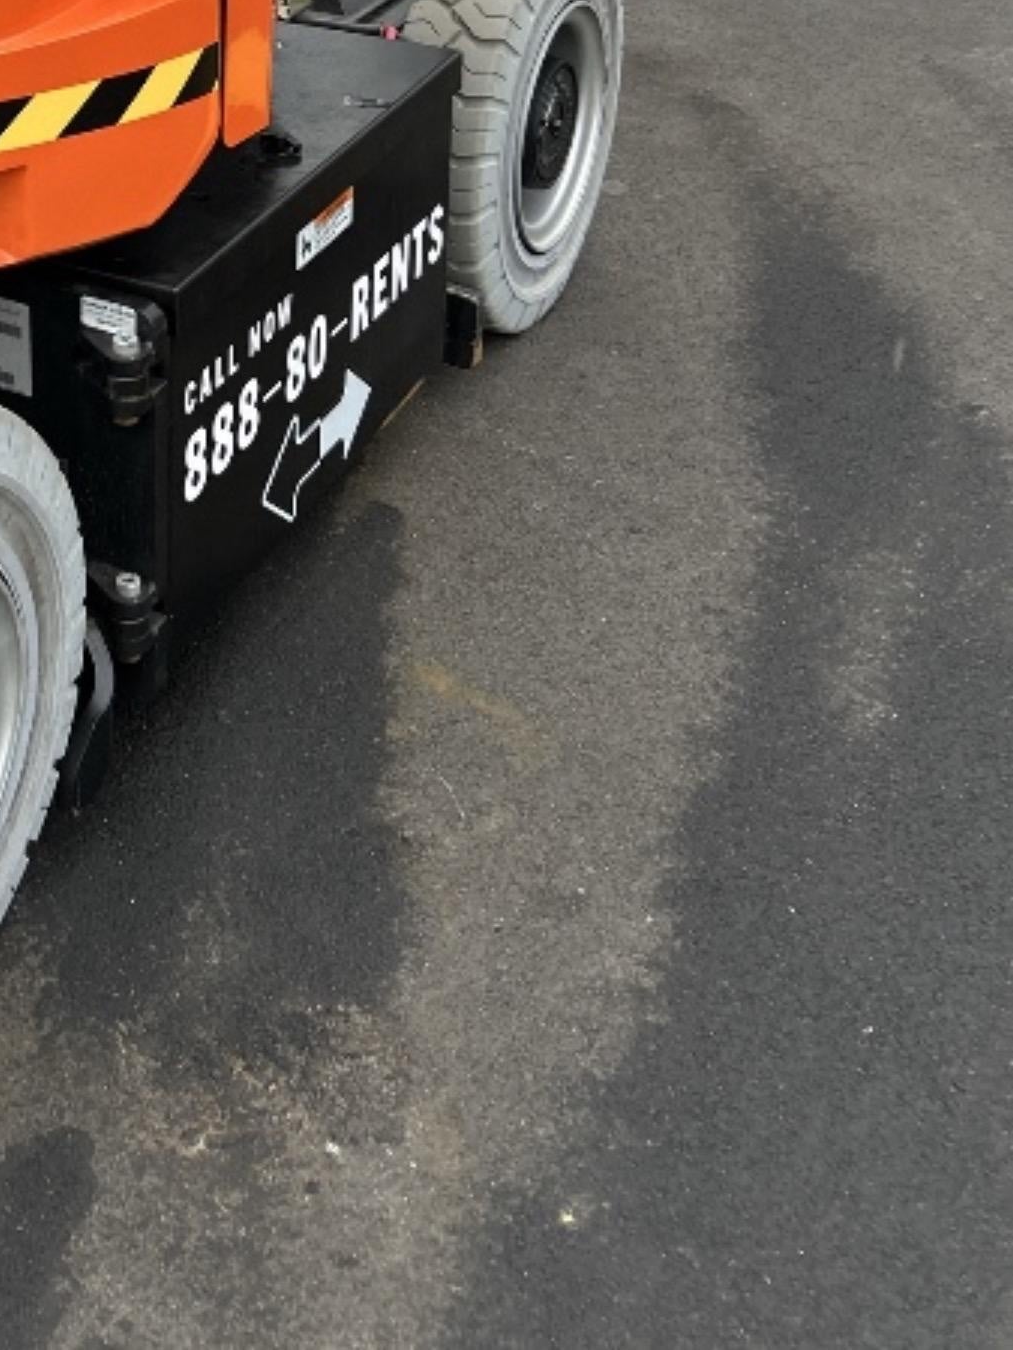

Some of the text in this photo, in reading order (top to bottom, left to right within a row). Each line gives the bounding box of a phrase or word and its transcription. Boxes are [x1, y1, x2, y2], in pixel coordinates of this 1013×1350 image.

[184, 203, 445, 503] 888-80-RENTS
[184, 293, 294, 415] CALL NOW
